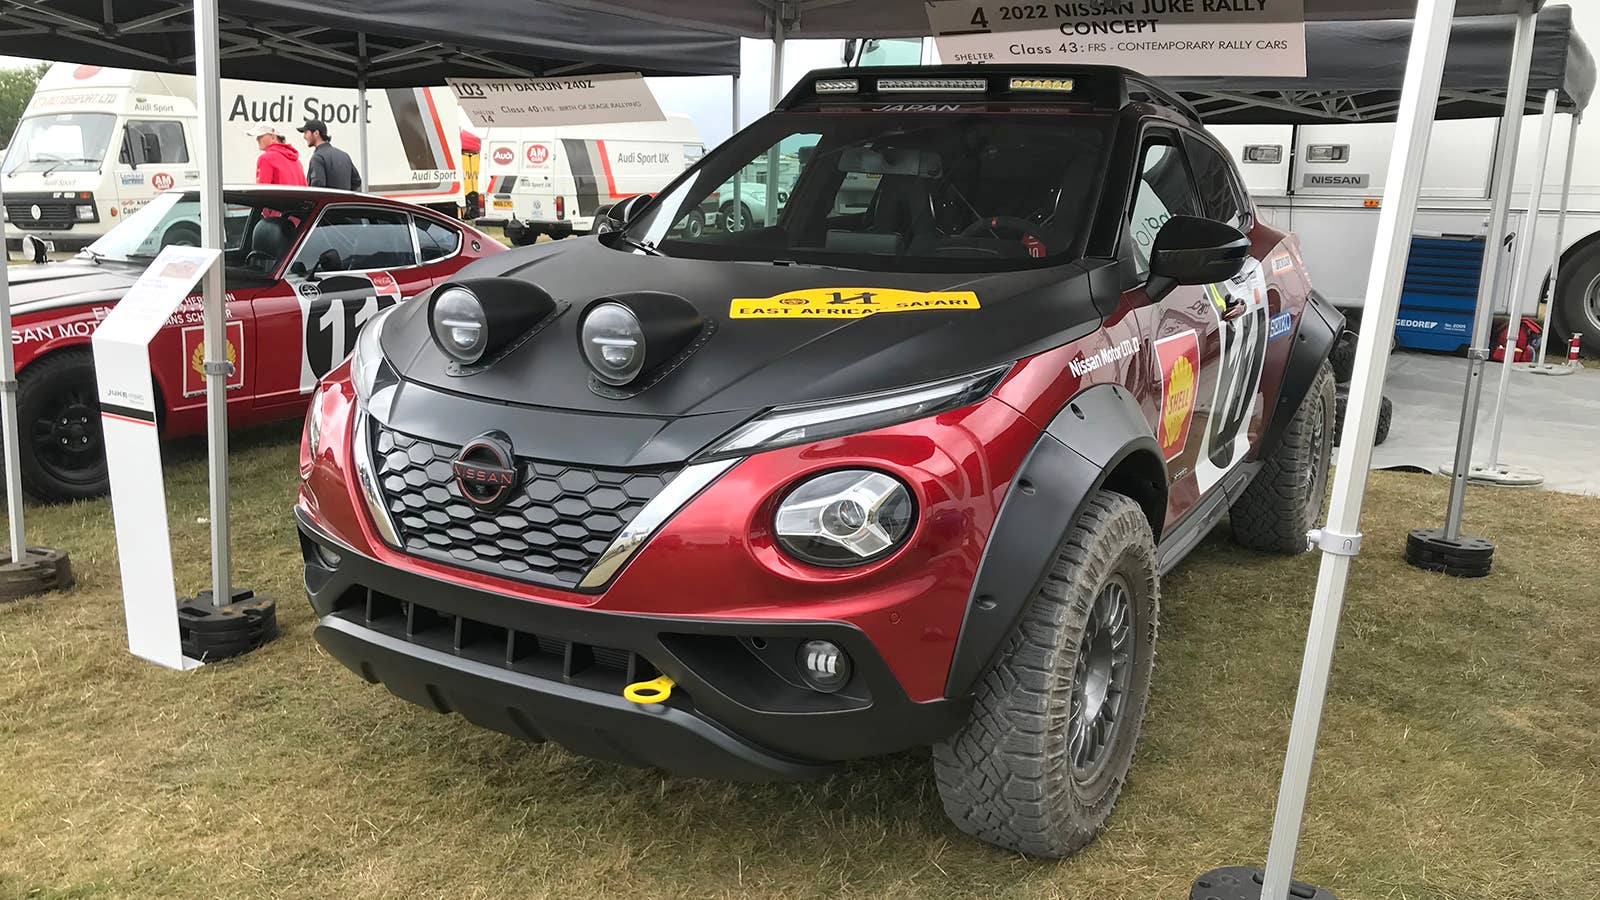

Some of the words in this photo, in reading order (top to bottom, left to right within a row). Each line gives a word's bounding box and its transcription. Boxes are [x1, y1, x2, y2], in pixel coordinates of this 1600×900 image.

[970, 6, 988, 28] 4
[1000, 5, 1048, 20] 2022
[1054, 1, 1135, 17] NISSAN
[1141, 0, 1194, 14] JUKE
[1202, 0, 1267, 13] RALLY
[1059, 19, 1159, 35] CONCEPT
[1009, 43, 1052, 56] Class
[1088, 43, 1107, 51] FRS
[1117, 40, 1215, 51] CONTEMPORARY
[1218, 40, 1253, 50] RALLY
[1255, 40, 1288, 50] CARS
[954, 53, 994, 62] SHELTER
[452, 82, 484, 96] 103
[486, 83, 512, 92] 1971
[514, 81, 563, 92] DATSUN
[564, 79, 595, 90] 240Z
[135, 103, 152, 111] Audi
[153, 104, 174, 113] Sport
[228, 94, 294, 123] Audi
[303, 96, 372, 124] Sport
[500, 105, 525, 114] Class
[872, 104, 960, 112] JAPAN
[481, 115, 495, 123] 14
[529, 147, 546, 158] AM
[617, 152, 636, 163] Audi
[636, 152, 658, 165] Sport
[658, 153, 670, 164] UK
[154, 175, 172, 185] AM
[411, 170, 432, 181] Audi
[433, 170, 457, 184] Sport
[1311, 175, 1361, 185] NISSAN
[740, 307, 790, 315] EAST
[896, 299, 969, 308] SAFARI
[11, 324, 54, 345] SAN
[57, 315, 100, 338] MOT
[1395, 318, 1432, 329] GEDORE
[1068, 356, 1103, 378] Nissan
[1100, 345, 1123, 366] Motor
[1168, 387, 1189, 416] SHELL
[454, 463, 513, 484] NISSAN
